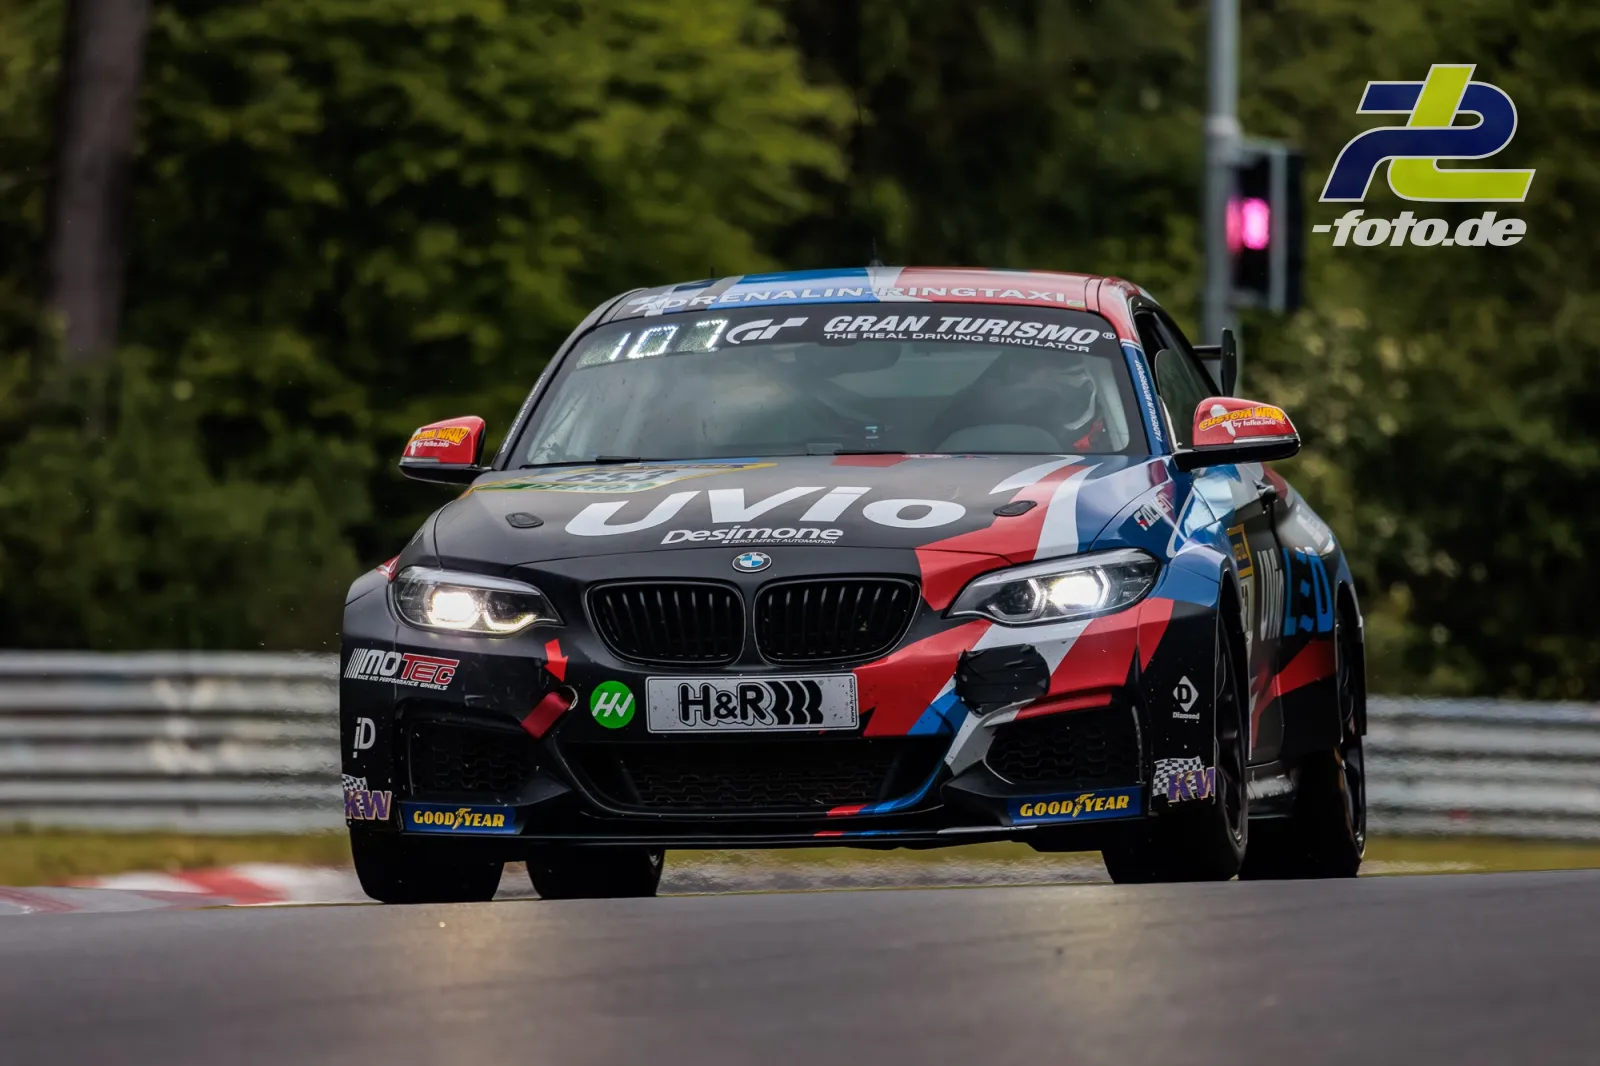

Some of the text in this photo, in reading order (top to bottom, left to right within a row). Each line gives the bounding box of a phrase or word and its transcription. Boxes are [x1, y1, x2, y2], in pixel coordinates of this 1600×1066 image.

[823, 315, 930, 333] GRAN
[862, 332, 908, 340] REAL
[912, 333, 984, 342] DRIVING
[989, 336, 1090, 353] SIMULATOR
[1199, 408, 1253, 431] CUSTOM
[660, 525, 844, 545] Desimone
[379, 677, 419, 687] PERFORMANCE
[420, 683, 448, 691] WHEELS
[680, 683, 770, 723] H&R
[1172, 711, 1200, 720] Diamond
[344, 790, 392, 821] KW
[1019, 793, 1130, 817] GOODYEAR
[413, 807, 505, 830] GOODYEAR
